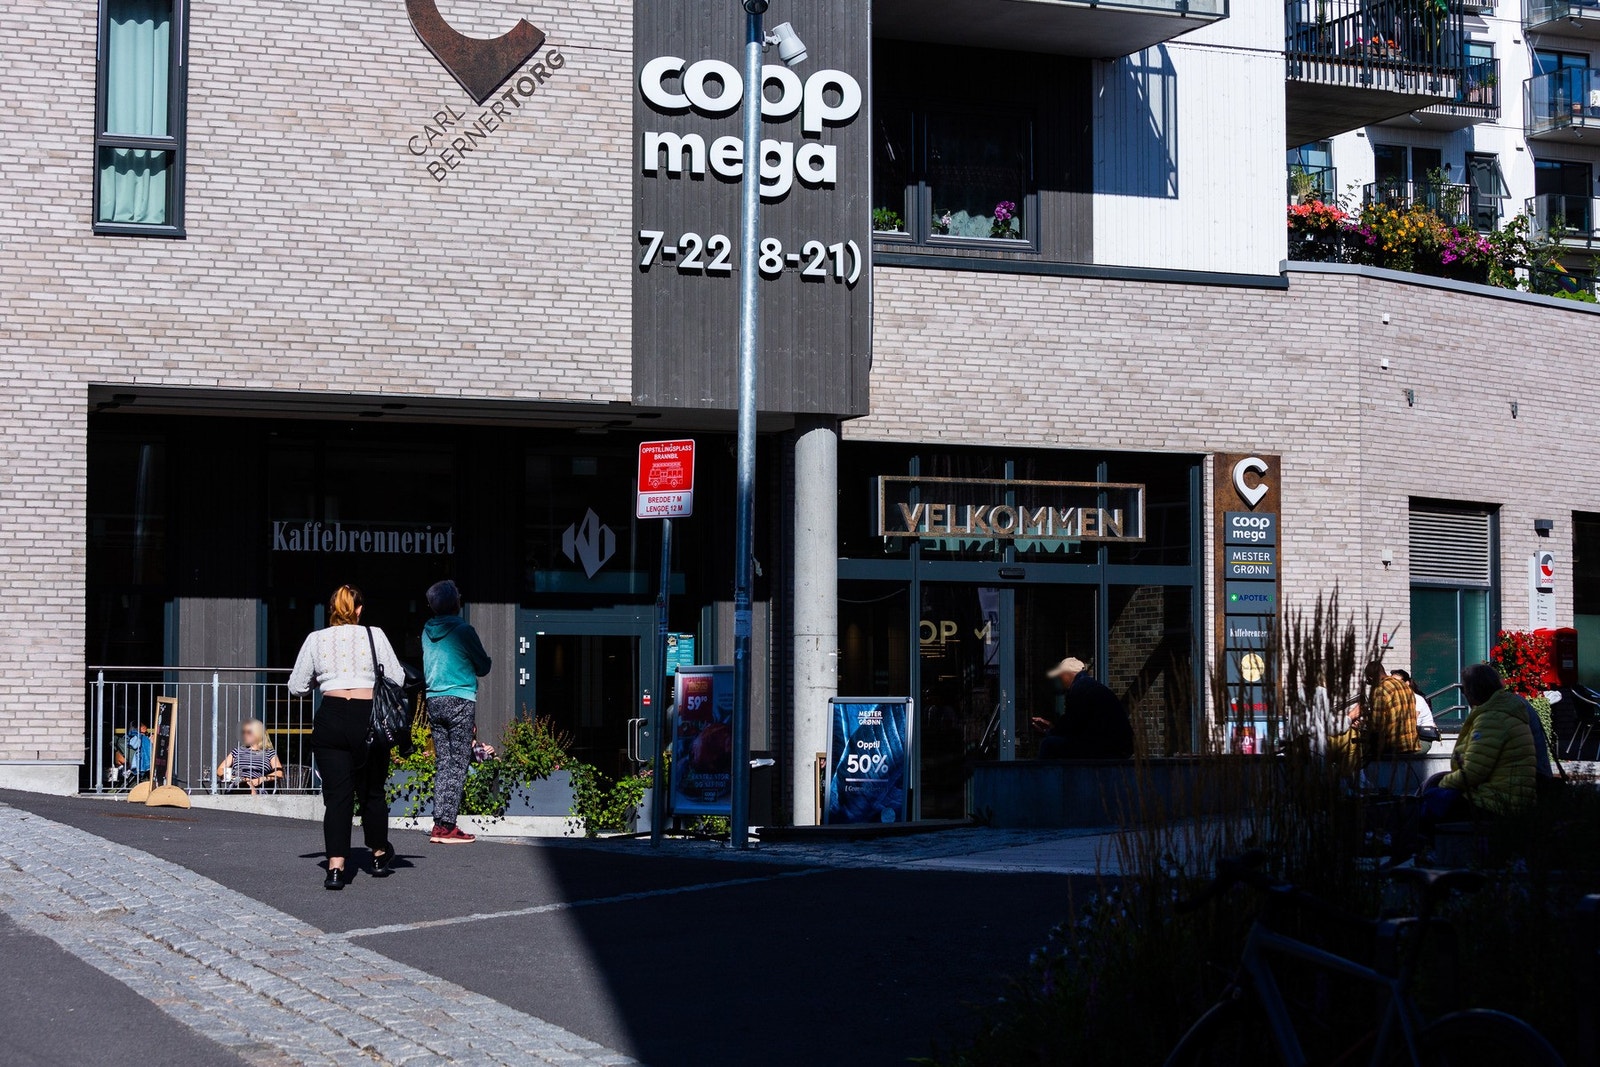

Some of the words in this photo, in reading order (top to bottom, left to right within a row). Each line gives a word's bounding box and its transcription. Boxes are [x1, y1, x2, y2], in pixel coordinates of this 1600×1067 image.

[640, 55, 863, 134] coop
[426, 49, 566, 183] BERNERTORG
[408, 105, 466, 157] CARL
[643, 131, 837, 199] mega
[640, 230, 733, 272] 7-22
[641, 445, 692, 454] OPPSTILLINGSPLASS
[653, 453, 679, 461] BRANNBIL
[647, 496, 671, 504] BREDDE
[646, 505, 669, 513] LENGDE
[898, 502, 1124, 539] VELKOMMEN
[1232, 516, 1270, 531] coop
[272, 520, 455, 556] Kaffebrenneriet
[1232, 530, 1267, 542] mega
[1233, 552, 1270, 562] MESTER
[1233, 564, 1270, 575] GRØNN
[1239, 594, 1268, 602] APOTEK
[1230, 628, 1268, 637] Kaffebrenner
[856, 740, 881, 751] Opptil
[846, 754, 889, 774] 50%
